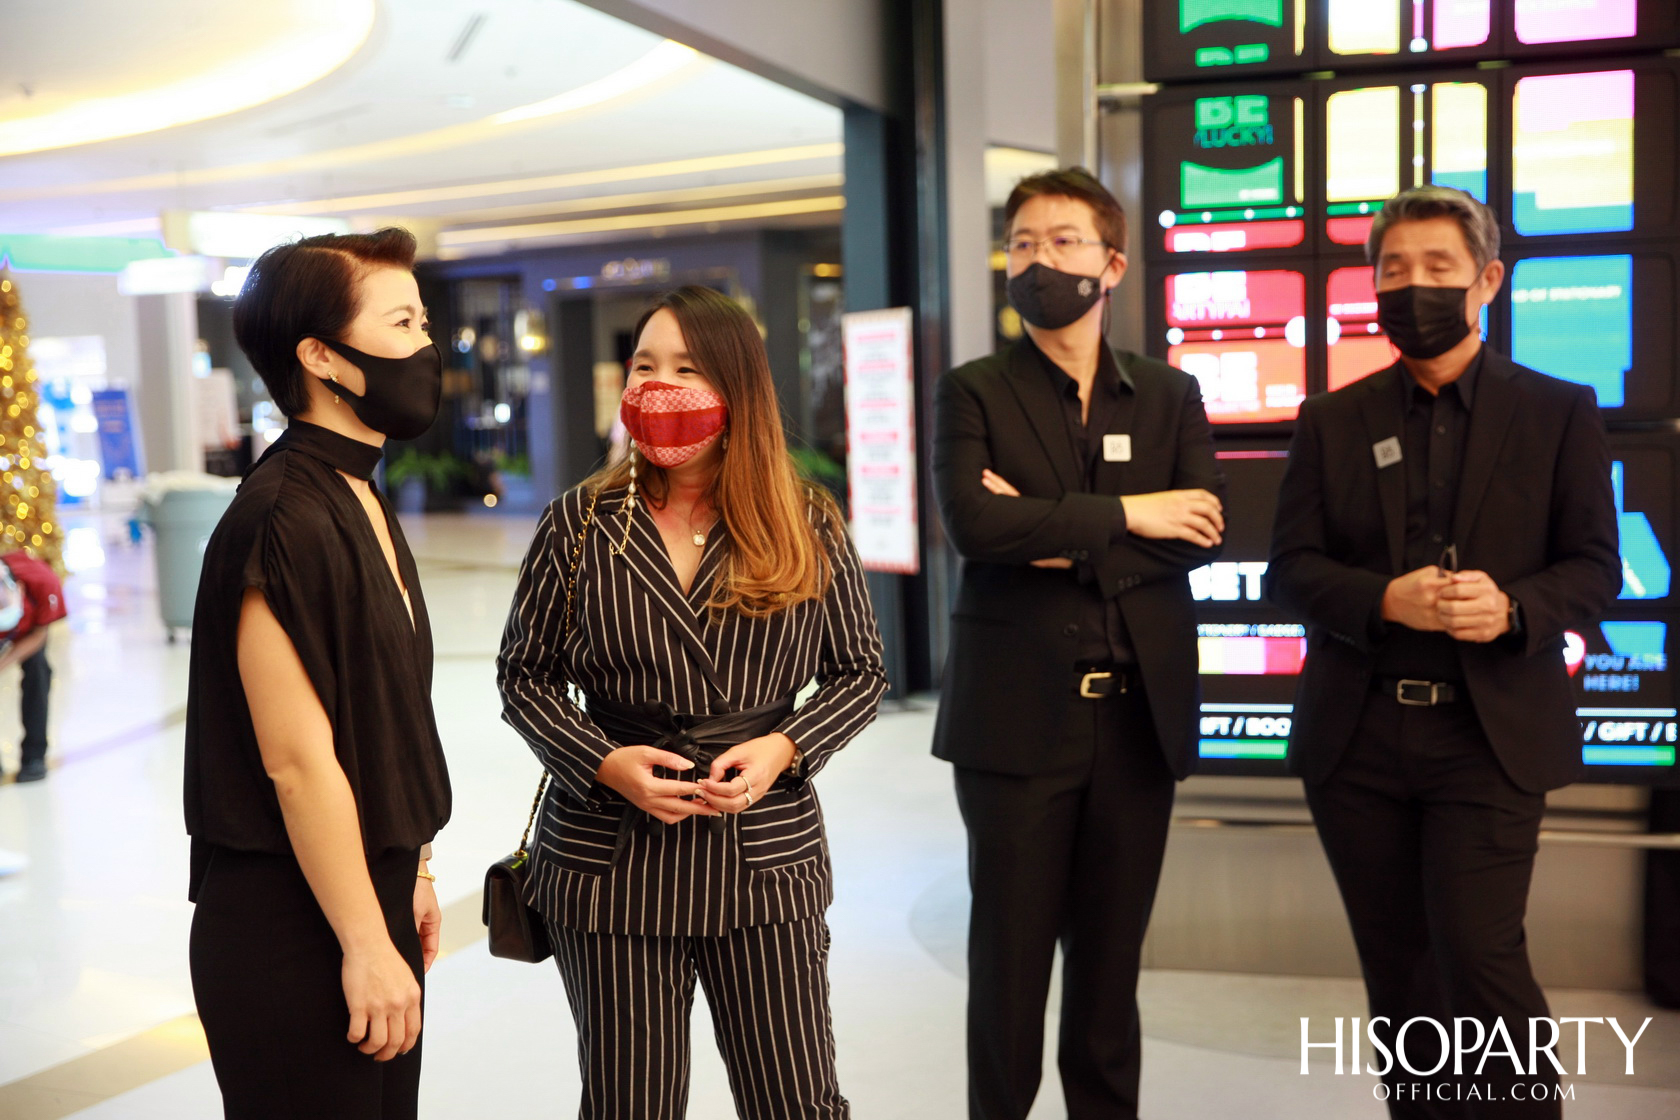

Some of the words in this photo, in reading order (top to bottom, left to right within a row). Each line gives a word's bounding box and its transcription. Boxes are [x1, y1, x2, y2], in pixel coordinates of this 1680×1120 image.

[1584, 653, 1625, 671] YOU
[1626, 653, 1668, 671] ARE
[1583, 674, 1640, 692] HERE!
[1598, 720, 1650, 742] GIFT
